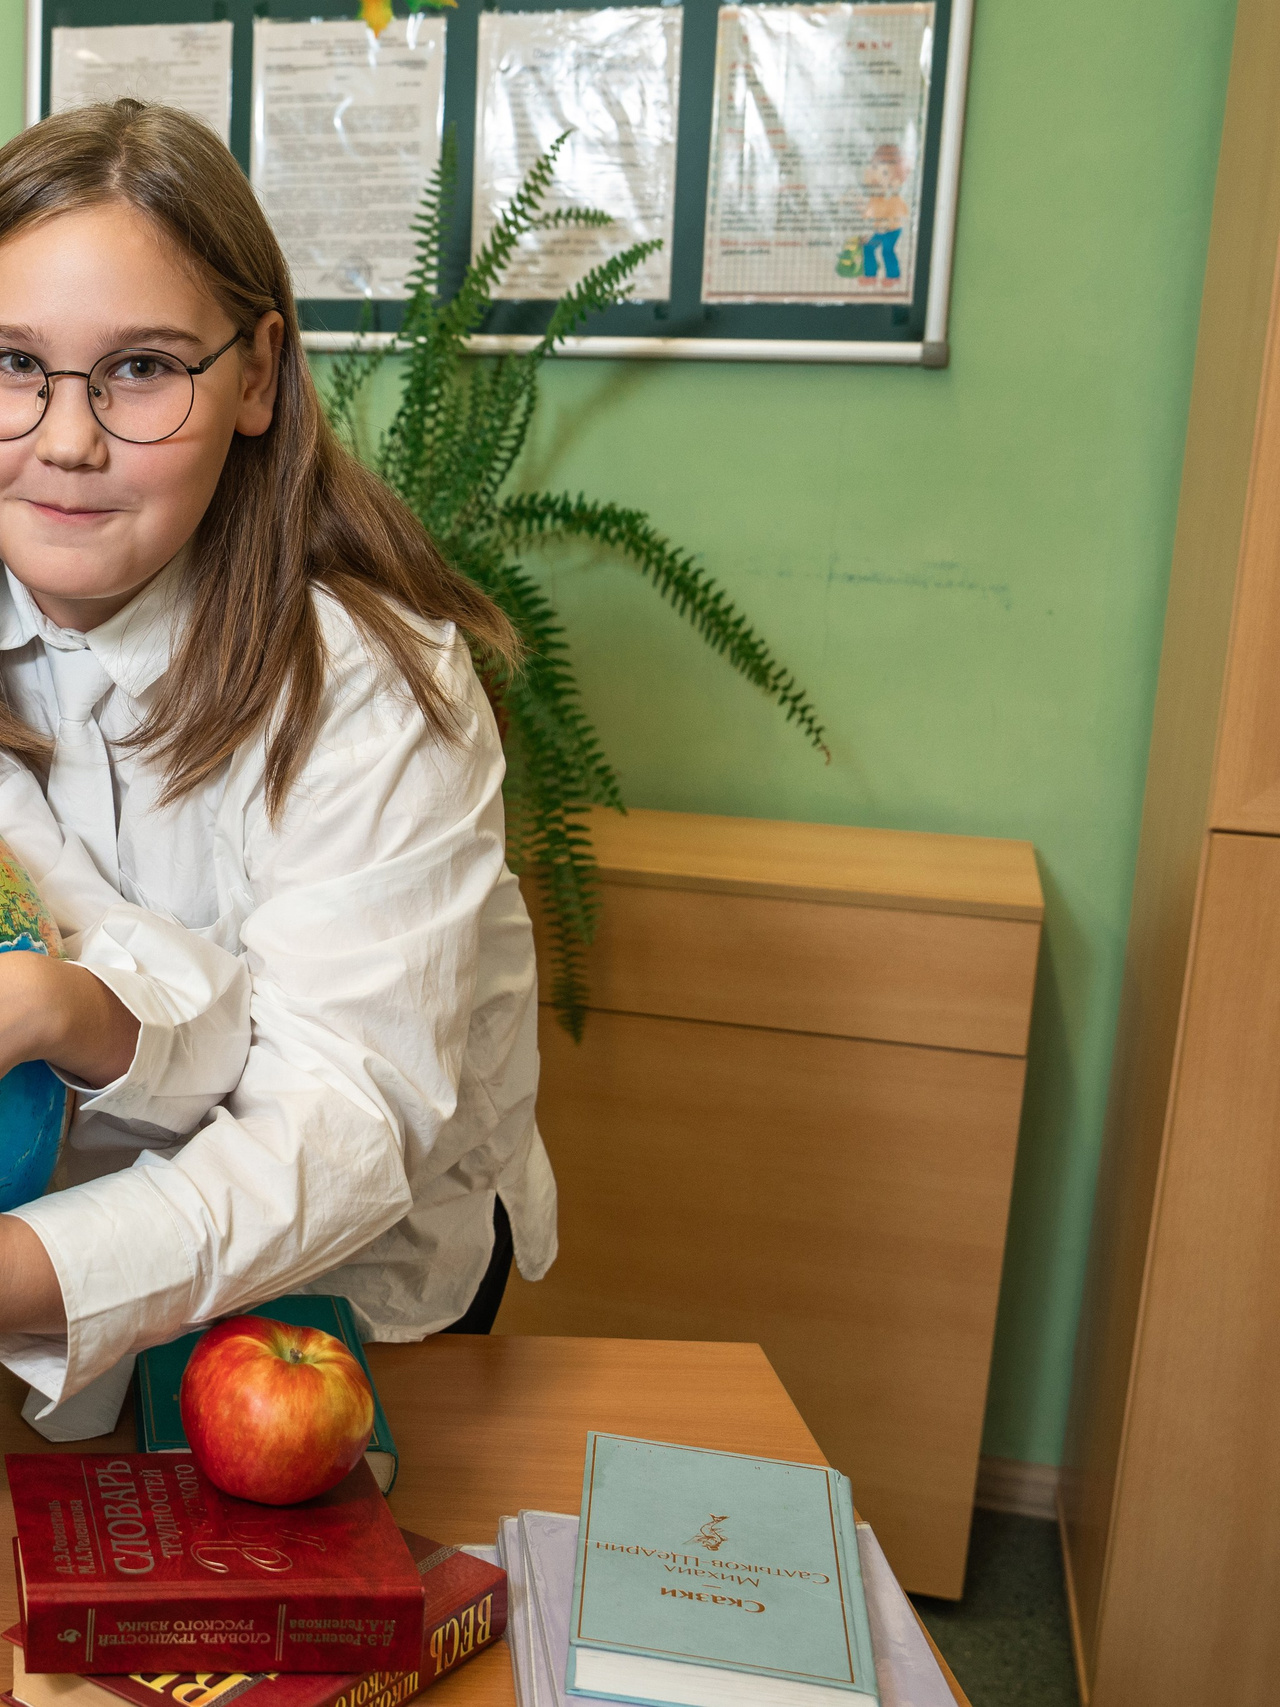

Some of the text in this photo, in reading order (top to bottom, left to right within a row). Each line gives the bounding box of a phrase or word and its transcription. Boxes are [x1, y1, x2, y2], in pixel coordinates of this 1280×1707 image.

[95, 1460, 155, 1575] СЛОВАРЬ
[138, 1469, 184, 1559] ТРУДНОСТЕЙ
[595, 1541, 830, 1584] Салтыков-Щедрин
[662, 1563, 760, 1588] Михаил
[659, 1586, 766, 1613] Сказки
[97, 1630, 271, 1646] СЛОВАРЬ ТРУДНОСТЕЙ
[115, 1618, 254, 1632] РУССКОГО ЯЗЫКА
[428, 1592, 493, 1675] ВЕСЬ
